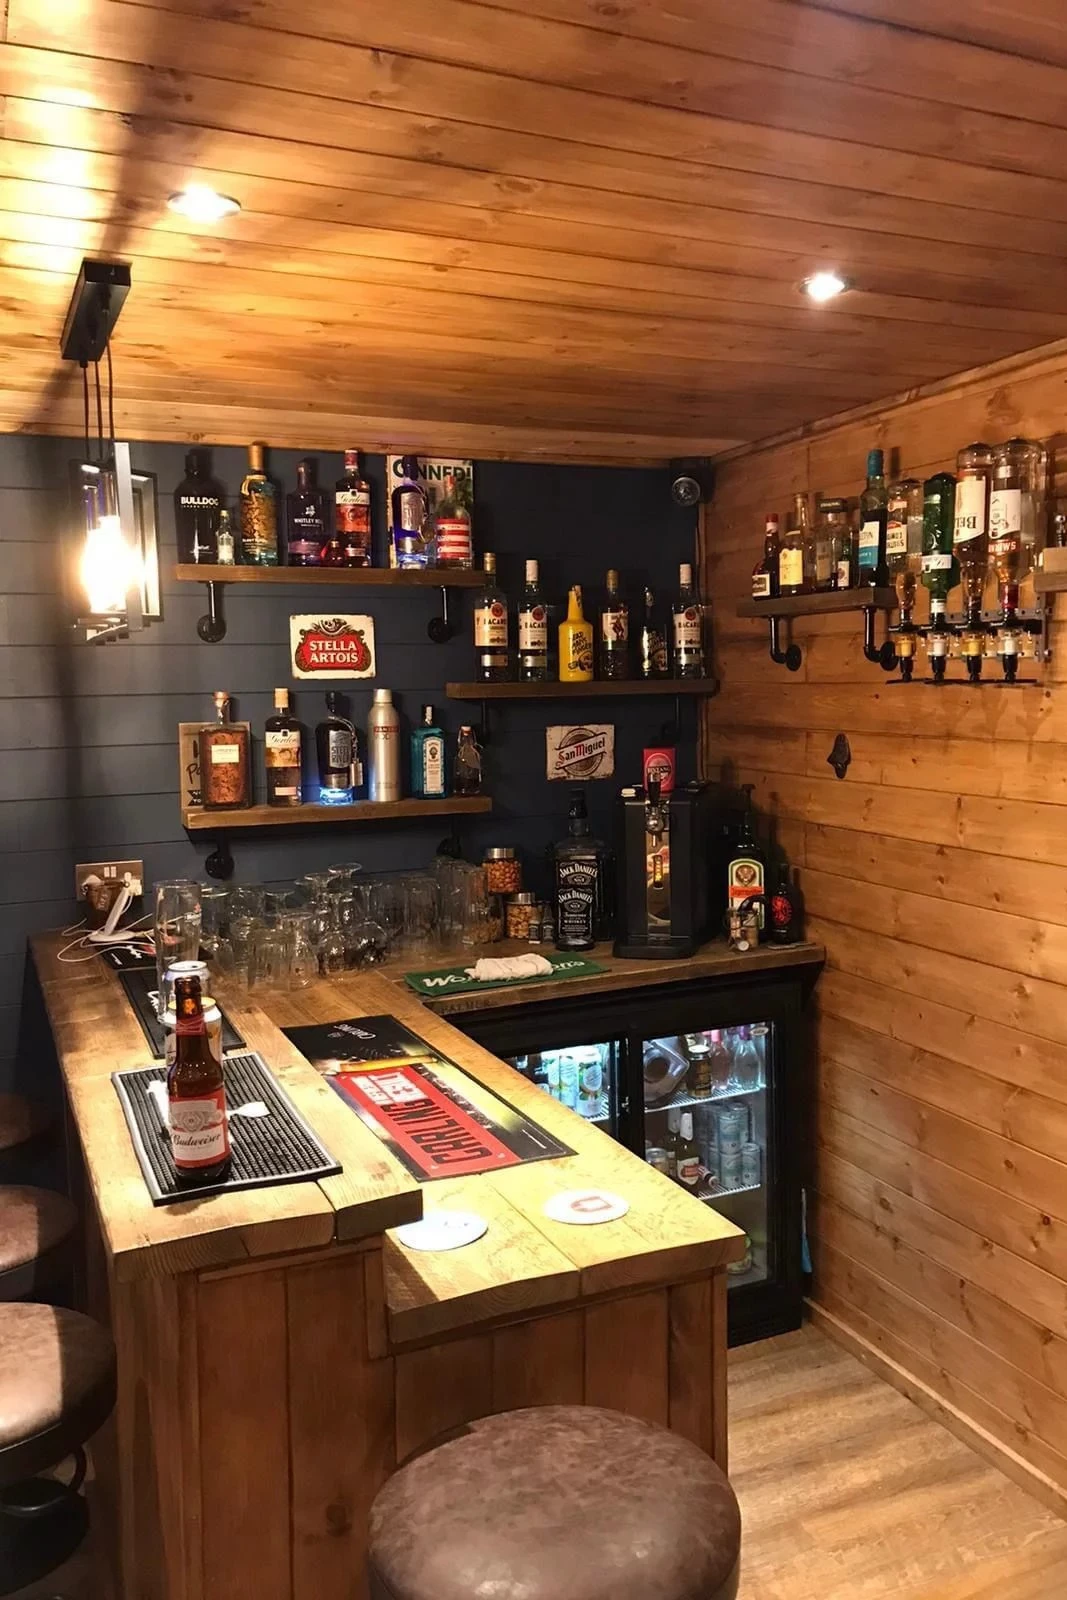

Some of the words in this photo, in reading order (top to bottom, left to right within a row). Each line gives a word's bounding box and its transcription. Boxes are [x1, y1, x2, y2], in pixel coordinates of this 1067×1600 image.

[393, 459, 472, 481] NNED!
[954, 515, 977, 529] BEL
[988, 541, 1017, 553] SMIRN
[309, 640, 357, 651] STELLA
[309, 652, 359, 663] ARTOIS
[559, 866, 575, 878] JACK
[558, 891, 572, 904] JACK
[380, 1098, 493, 1164] CARLING
[172, 1133, 221, 1146] Budweiser
